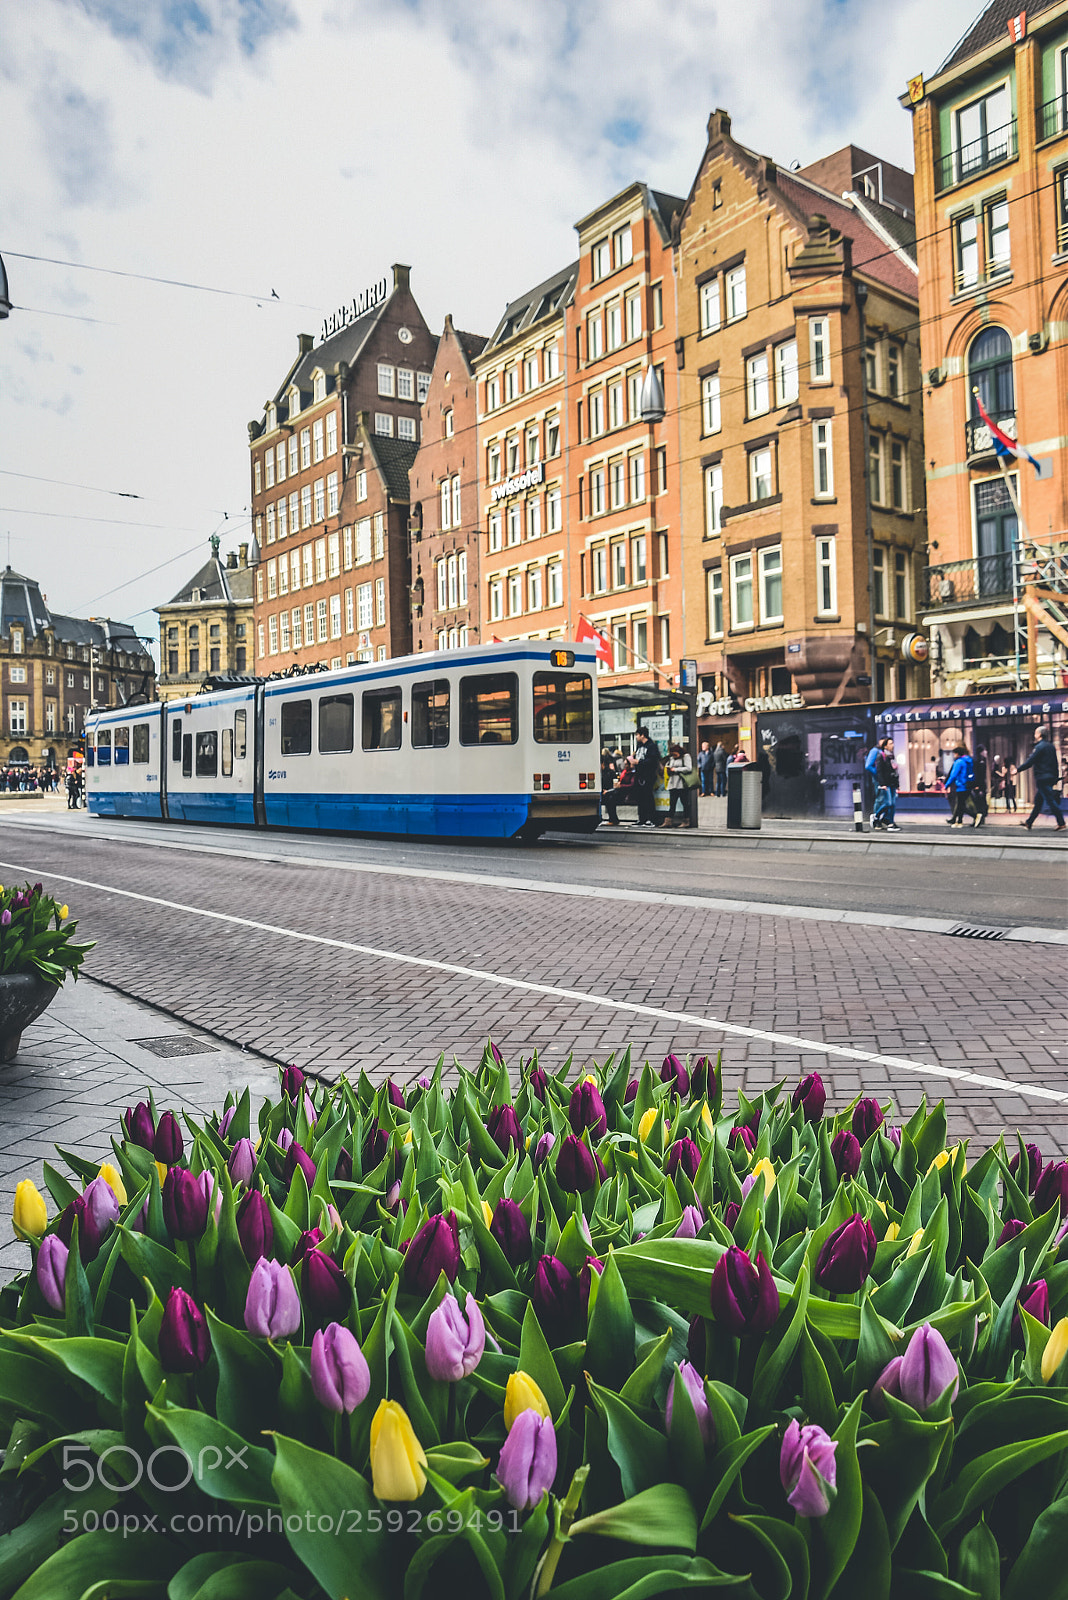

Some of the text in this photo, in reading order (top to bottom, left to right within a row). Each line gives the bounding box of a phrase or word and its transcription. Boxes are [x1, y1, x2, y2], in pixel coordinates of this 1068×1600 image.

[696, 690, 805, 718] Pott CHANGE
[874, 712, 921, 724] HOTEL
[930, 704, 1032, 720] AMSTERDAM
[557, 750, 571, 758] 841
